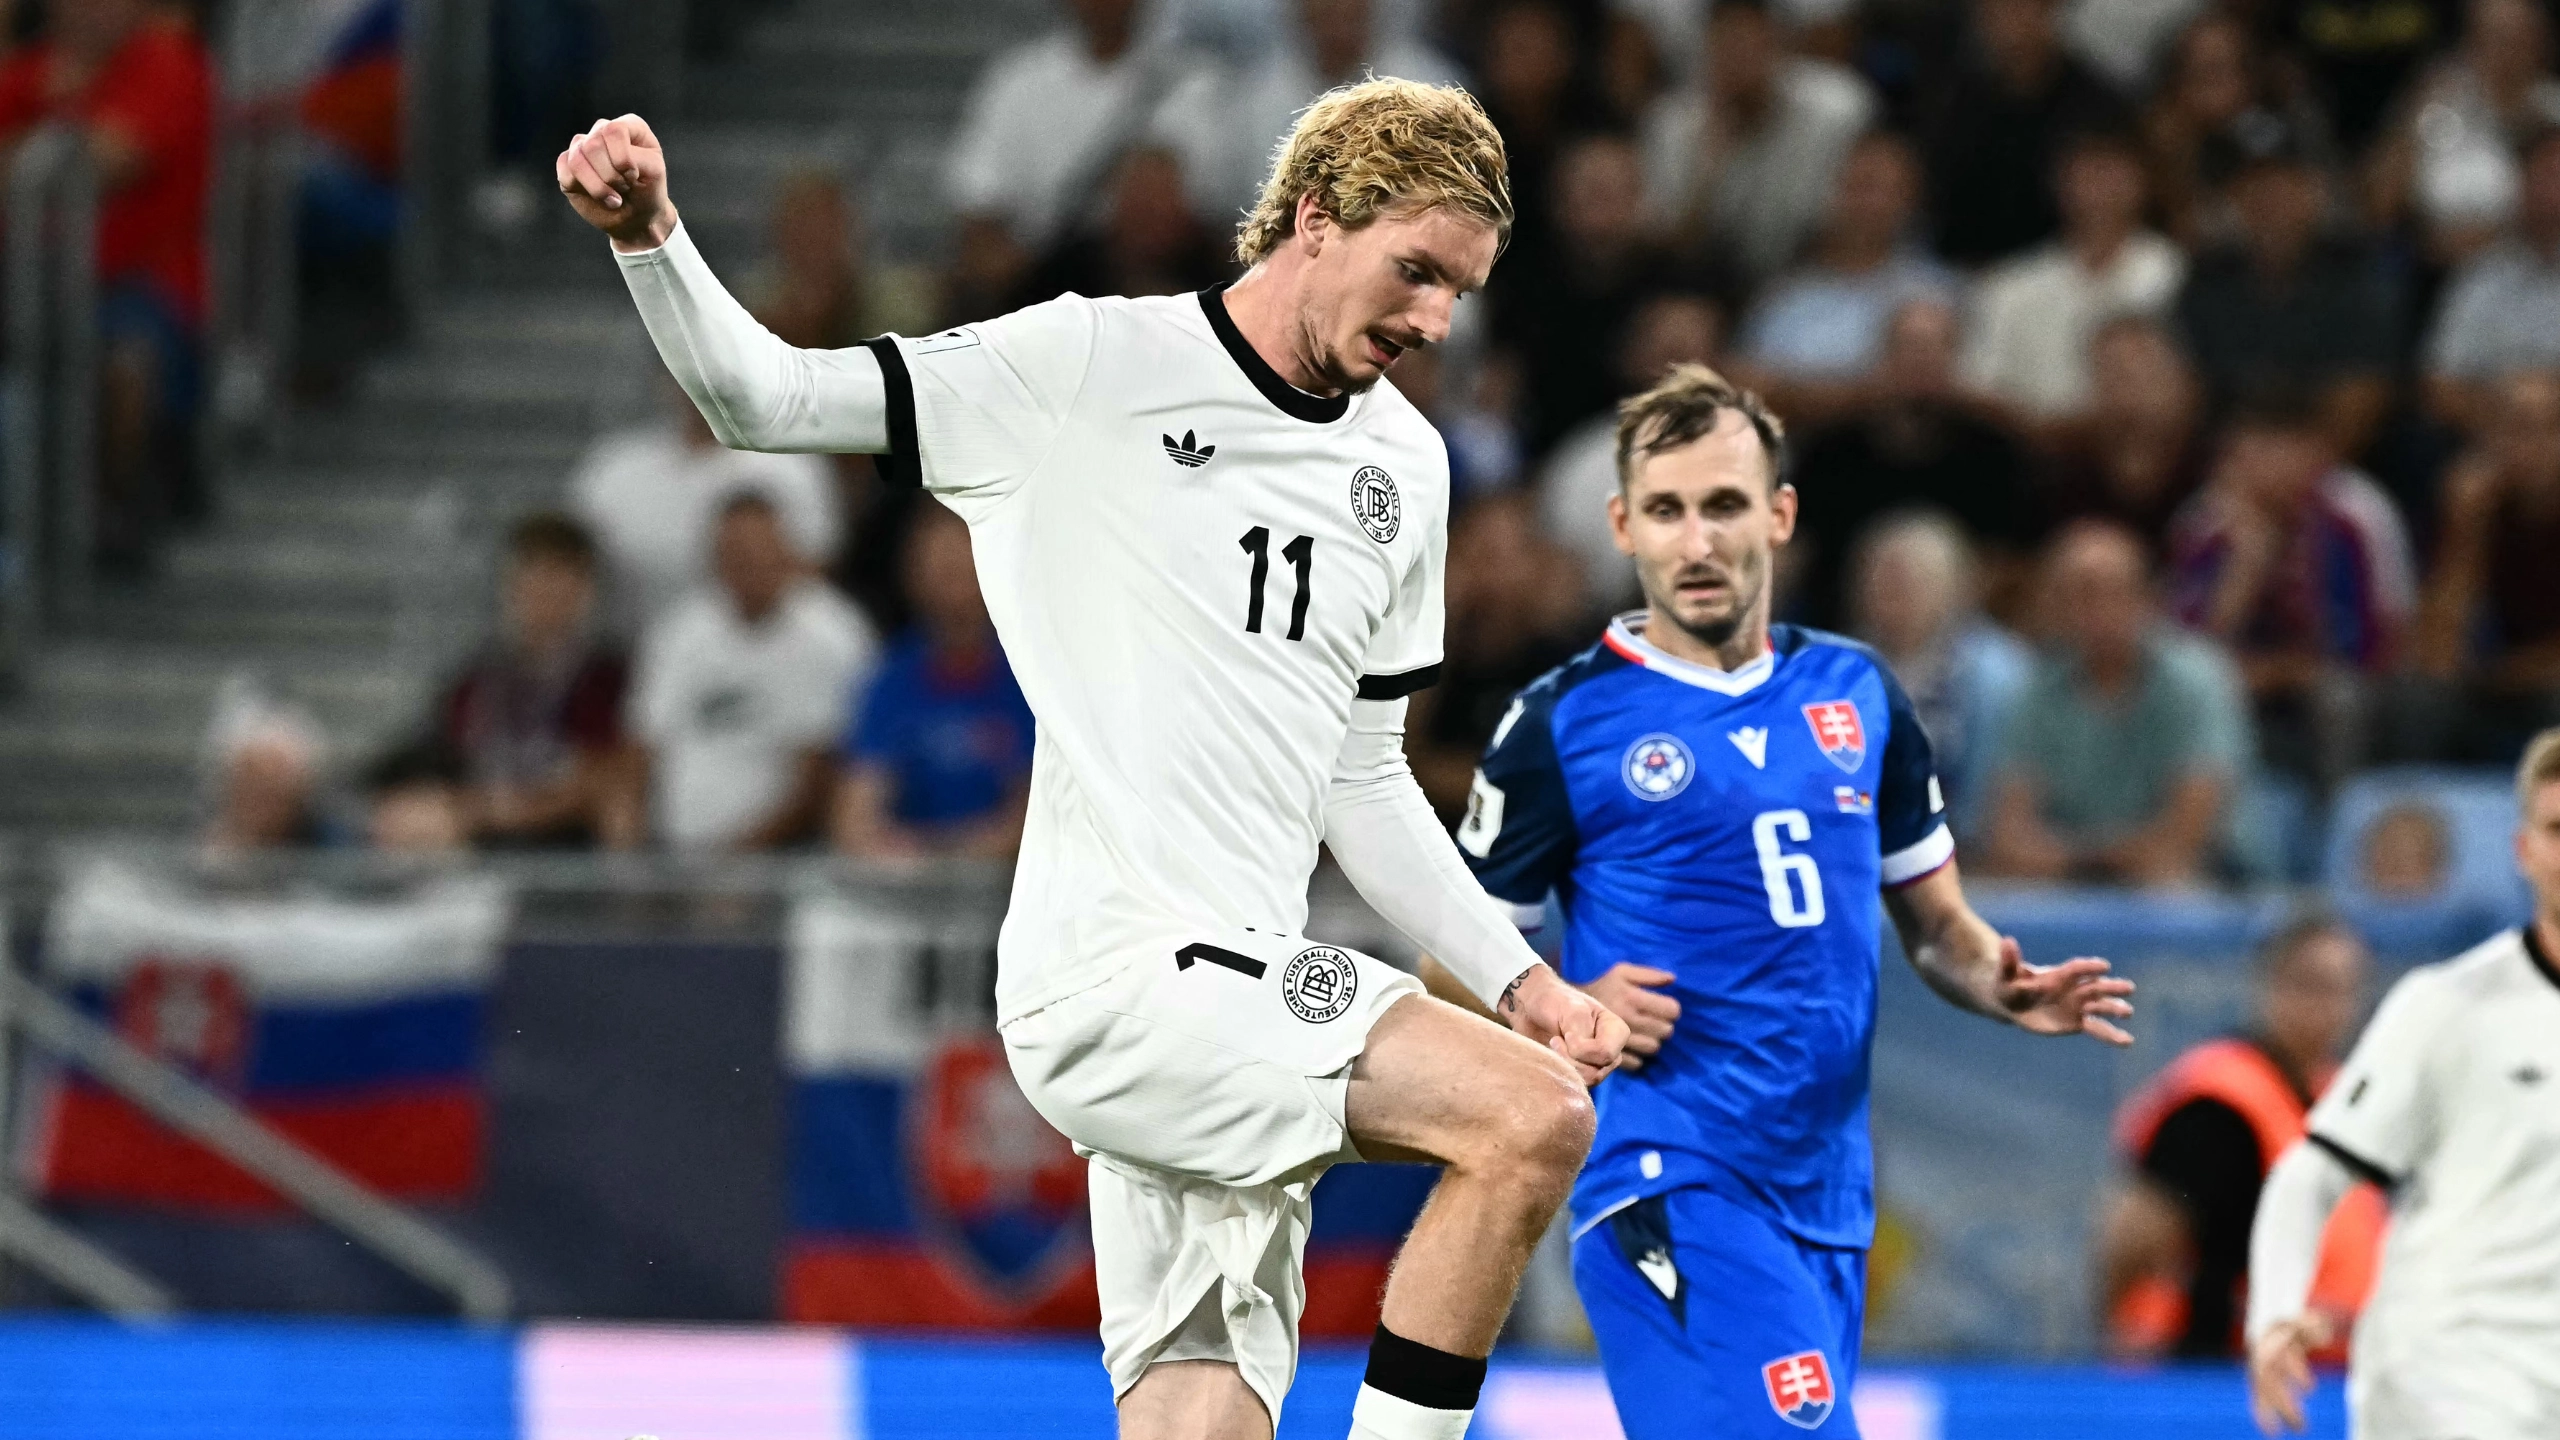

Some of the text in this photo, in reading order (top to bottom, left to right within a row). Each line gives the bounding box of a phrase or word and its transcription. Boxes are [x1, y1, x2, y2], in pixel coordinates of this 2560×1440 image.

[1353, 470, 1368, 525] DEUTSCHER
[1372, 528, 1383, 539] 125
[1238, 525, 1315, 642] 11
[1751, 808, 1826, 929] 6
[1175, 927, 1287, 980] 1
[1286, 988, 1339, 1020] DEUTSCHER
[1341, 986, 1353, 1002] 125
